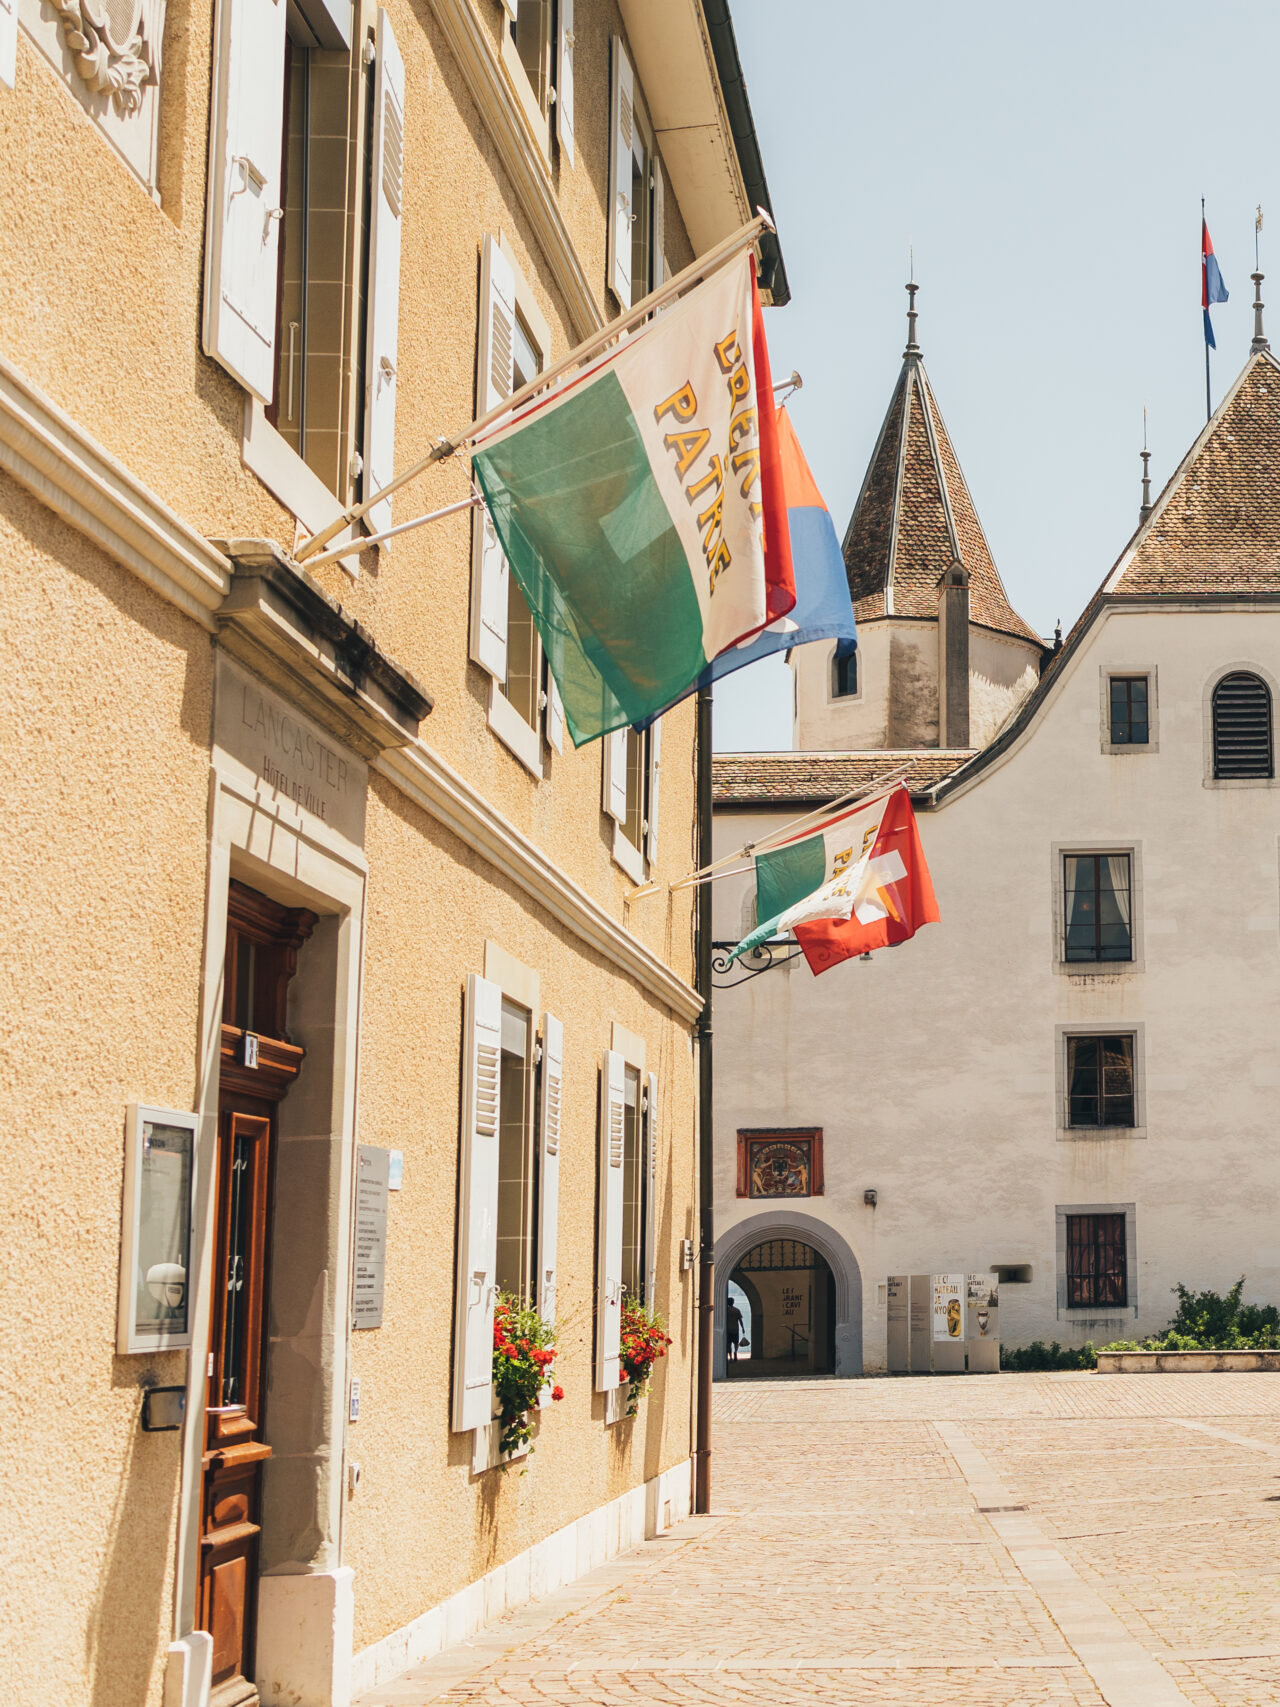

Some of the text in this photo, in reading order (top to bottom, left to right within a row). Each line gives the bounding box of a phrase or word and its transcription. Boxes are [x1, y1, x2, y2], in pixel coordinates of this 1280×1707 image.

[242, 685, 349, 796] LANCASTER
[292, 781, 303, 805] DE
[304, 785, 327, 821] VILLE
